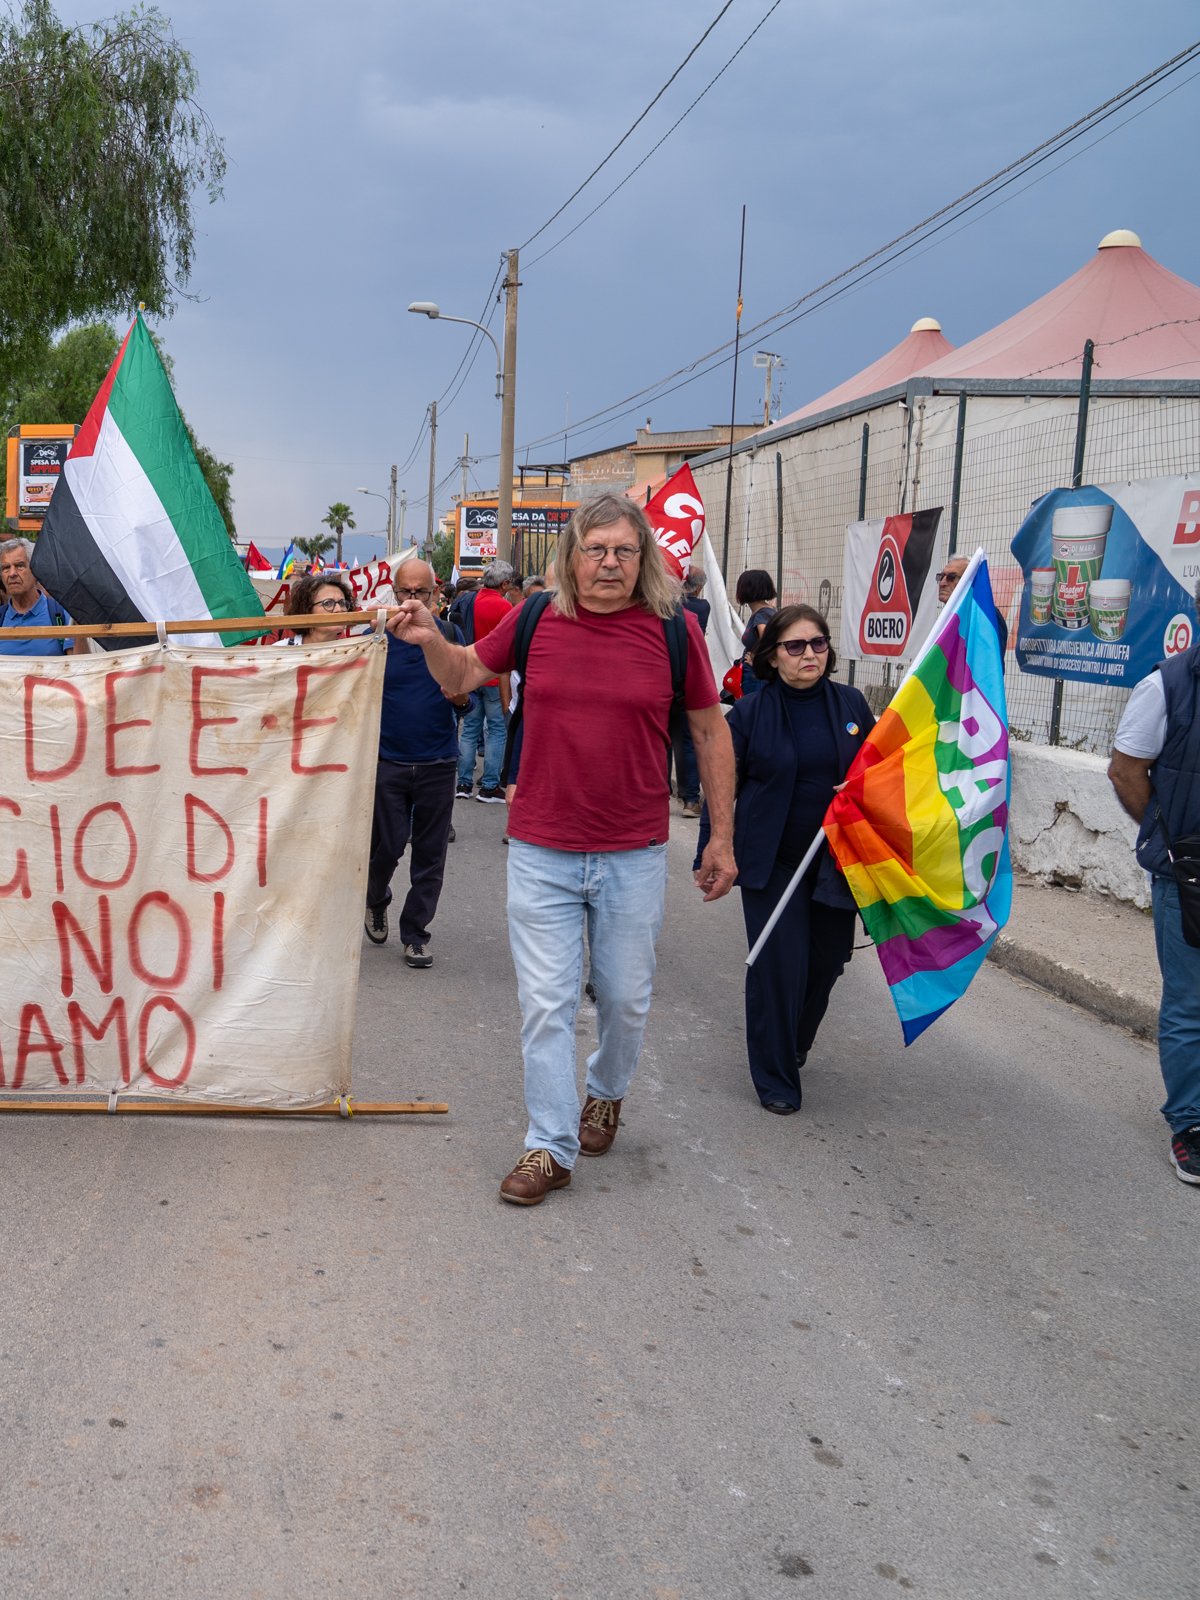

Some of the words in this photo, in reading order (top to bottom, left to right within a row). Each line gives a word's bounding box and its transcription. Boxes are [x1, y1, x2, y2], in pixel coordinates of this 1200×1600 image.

[867, 615, 904, 639] BOERO
[1094, 643, 1130, 660] ANTIMUFFA
[1059, 658, 1081, 672] SUCCESSI
[1081, 661, 1099, 673] CONTRO
[1100, 663, 1107, 674] LA
[1107, 663, 1124, 677] MUFFA
[184, 793, 268, 888] DI
[52, 890, 225, 998] NOI
